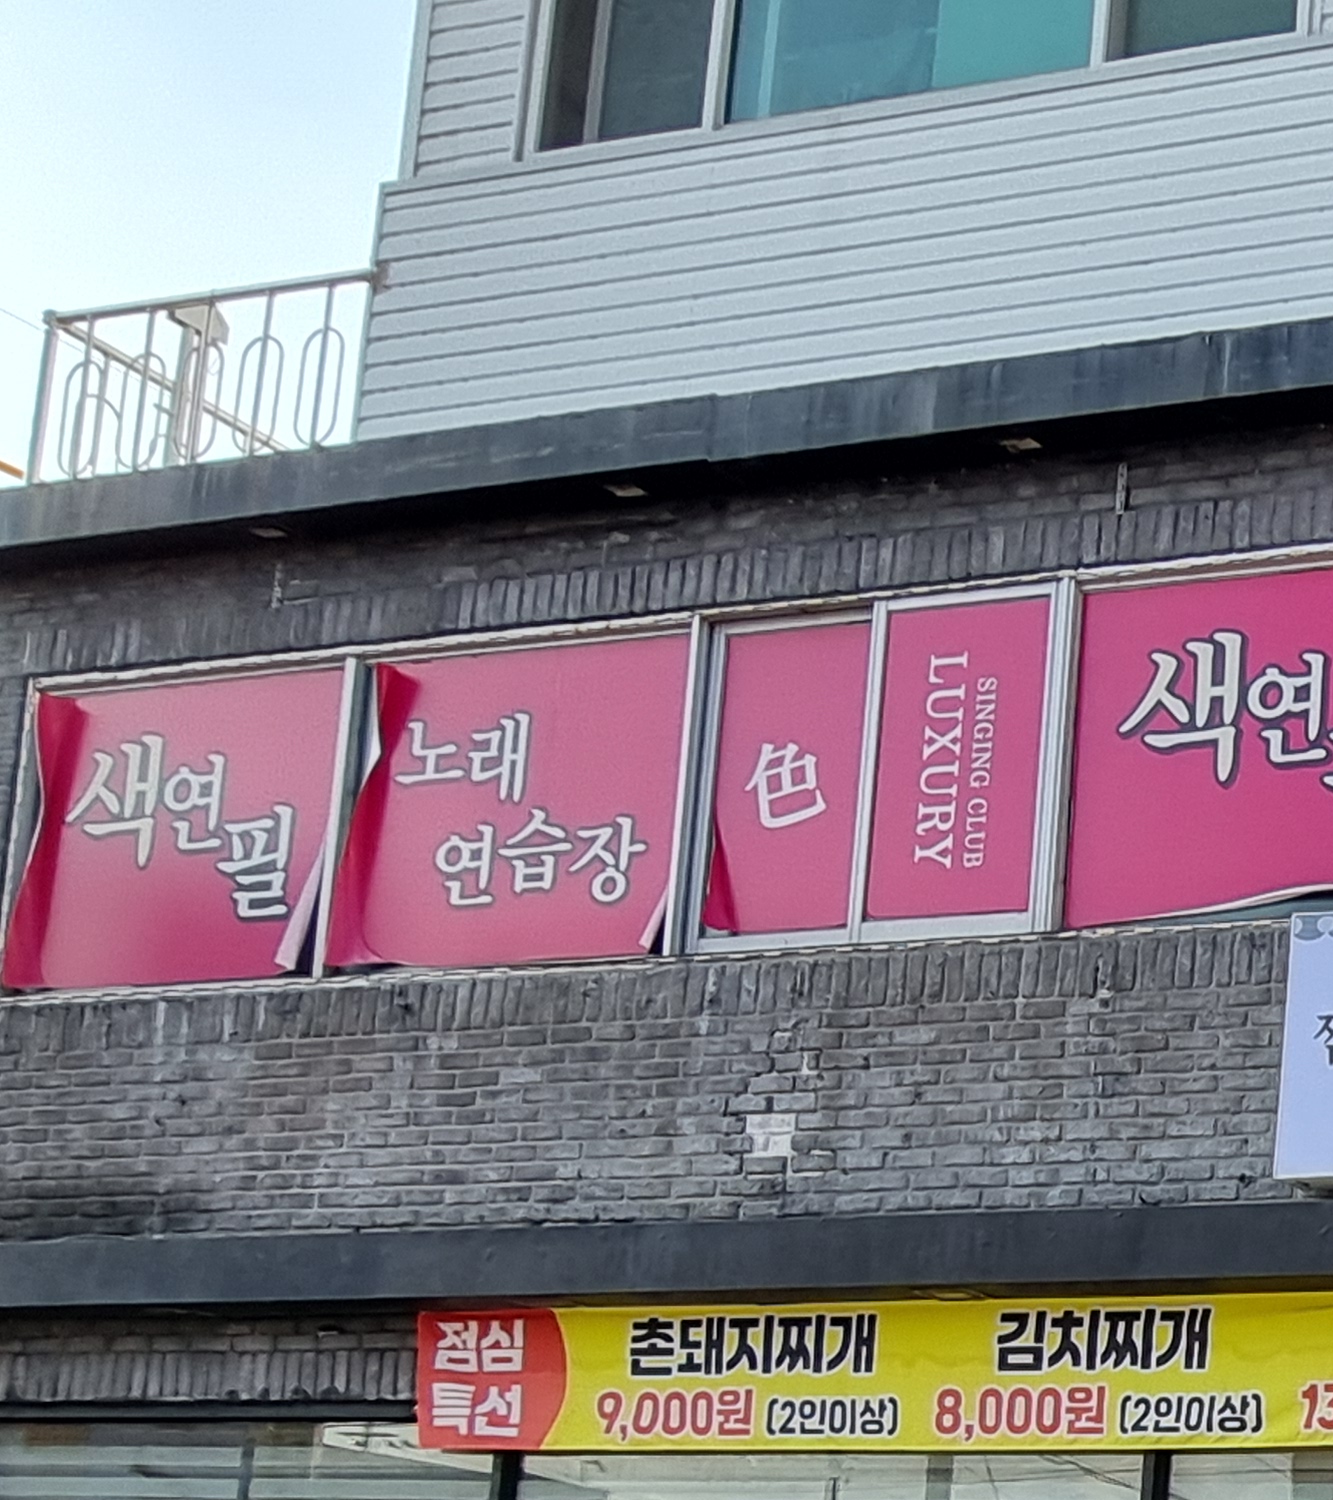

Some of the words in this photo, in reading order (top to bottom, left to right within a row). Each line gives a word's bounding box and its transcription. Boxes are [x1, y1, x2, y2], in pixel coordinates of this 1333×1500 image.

[395, 712, 532, 801] 노래
[914, 650, 968, 869] LUXURY
[969, 676, 998, 789] SINGING
[745, 742, 828, 829] 色
[66, 733, 296, 918] 색연필
[433, 811, 647, 905] 연습장
[963, 797, 988, 869] CLUB
[434, 1318, 524, 1373] 점심
[629, 1314, 878, 1377] 촌돼지찌개
[996, 1307, 1213, 1372] 김치찌개
[431, 1382, 522, 1437] 특선
[597, 1389, 753, 1442] 9,000원
[766, 1397, 898, 1437] (2인이상)
[935, 1386, 1106, 1442] 8,000원
[1119, 1393, 1264, 1434] (2인이상)
